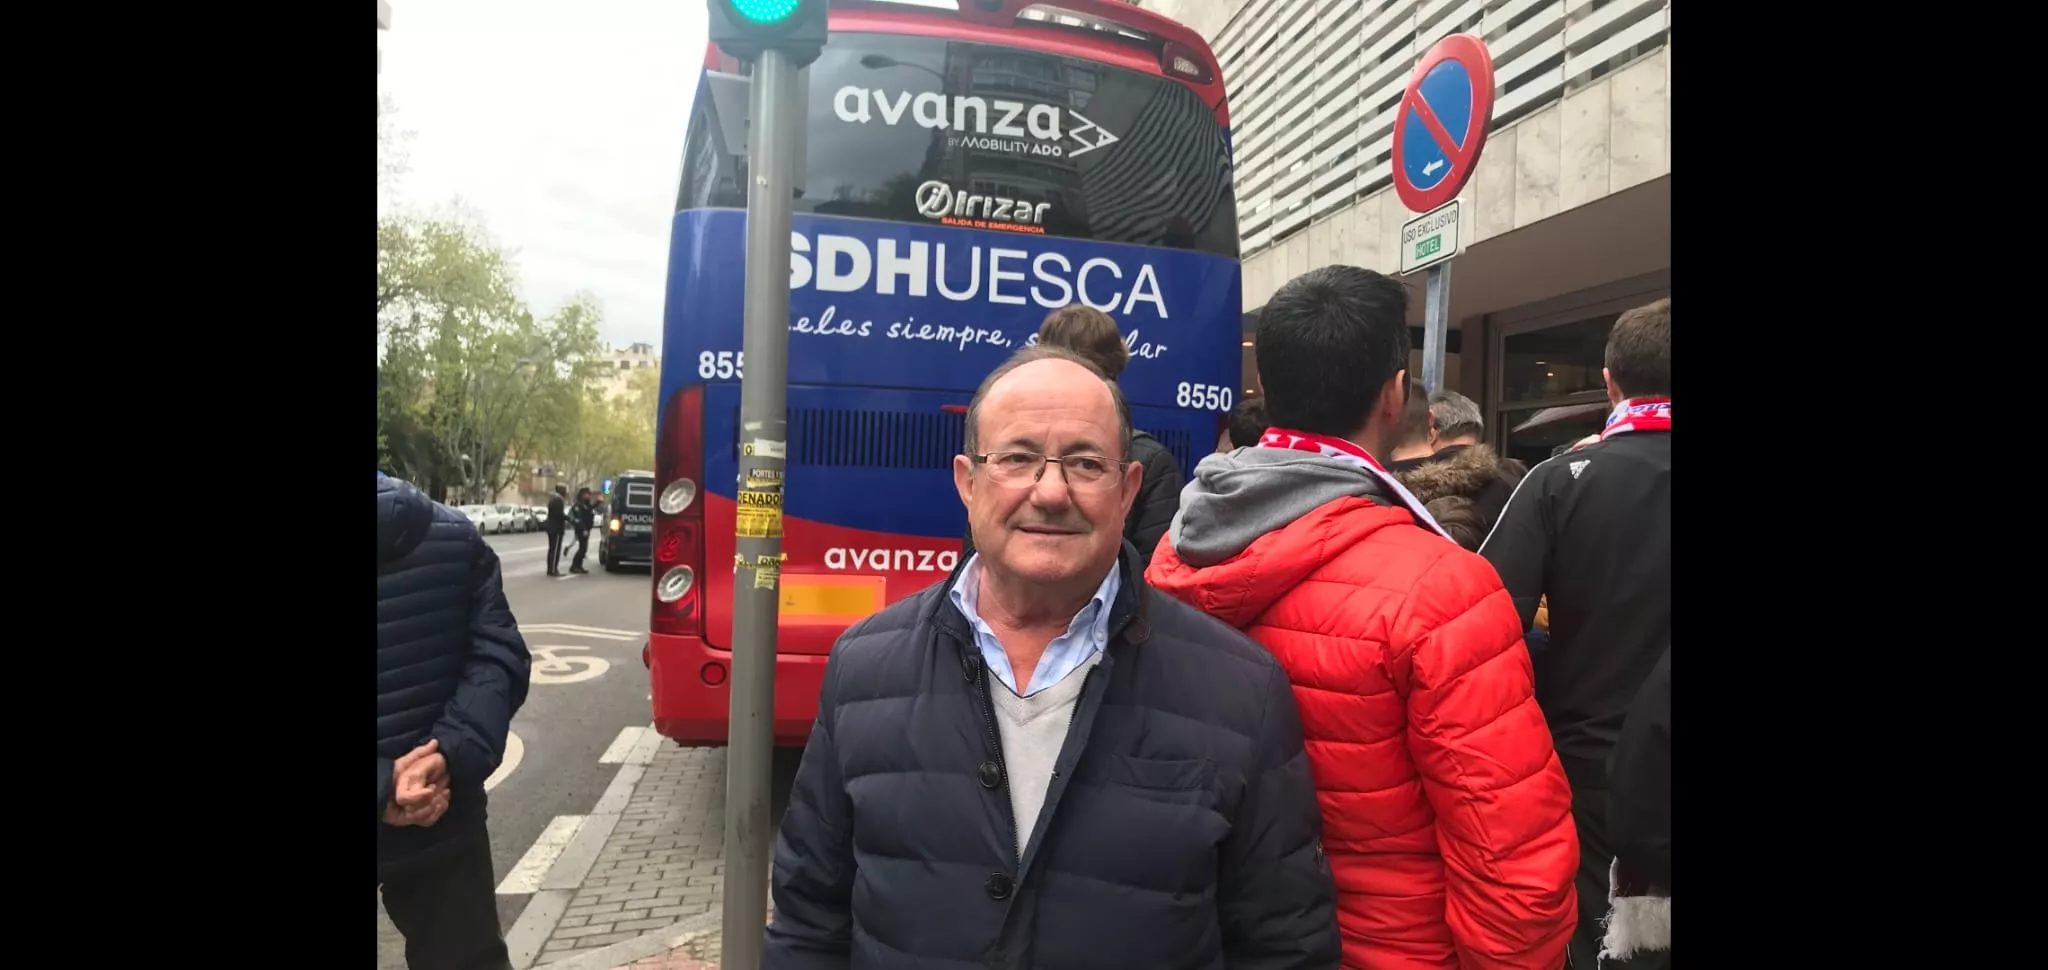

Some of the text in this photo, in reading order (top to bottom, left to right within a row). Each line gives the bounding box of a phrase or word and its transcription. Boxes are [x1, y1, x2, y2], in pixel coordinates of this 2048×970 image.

[833, 85, 1063, 141] avanza
[948, 136, 1062, 157] BY MOBILITY ADO
[954, 189, 1052, 225] Irizar
[941, 216, 1045, 235] SALIDA DE EMERGENCIA
[1403, 209, 1456, 243] USO EXCLUSIVO
[1416, 237, 1440, 258] HOTEL
[788, 305, 873, 337] eles
[886, 315, 1013, 352] siempre,
[698, 350, 744, 380] 855
[1176, 381, 1233, 412] 8550
[823, 546, 958, 572] avanza
